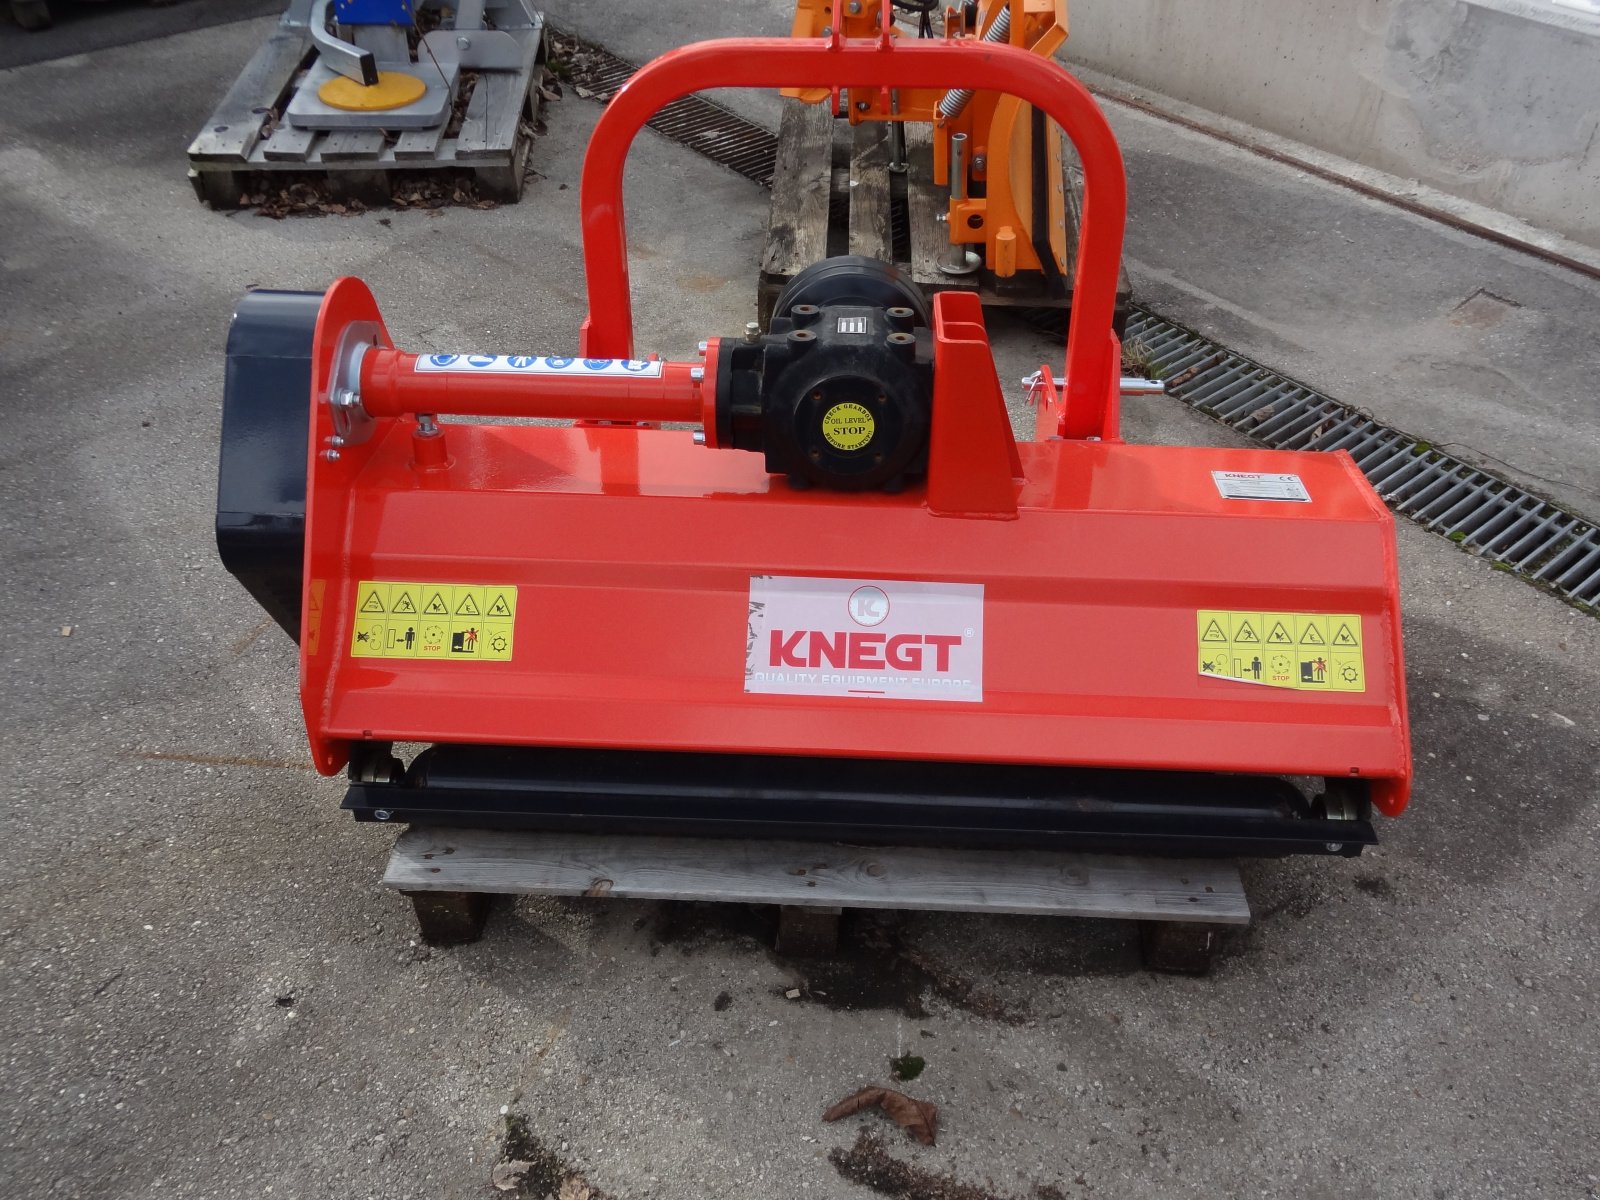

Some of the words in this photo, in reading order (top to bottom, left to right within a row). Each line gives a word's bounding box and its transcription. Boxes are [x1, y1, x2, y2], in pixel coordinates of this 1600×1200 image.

[824, 406, 841, 424] CHECK
[833, 427, 866, 435] STOP
[769, 629, 962, 672] KNEGT
[754, 671, 818, 685] QUALITY
[821, 673, 908, 687] EQUIPMENT
